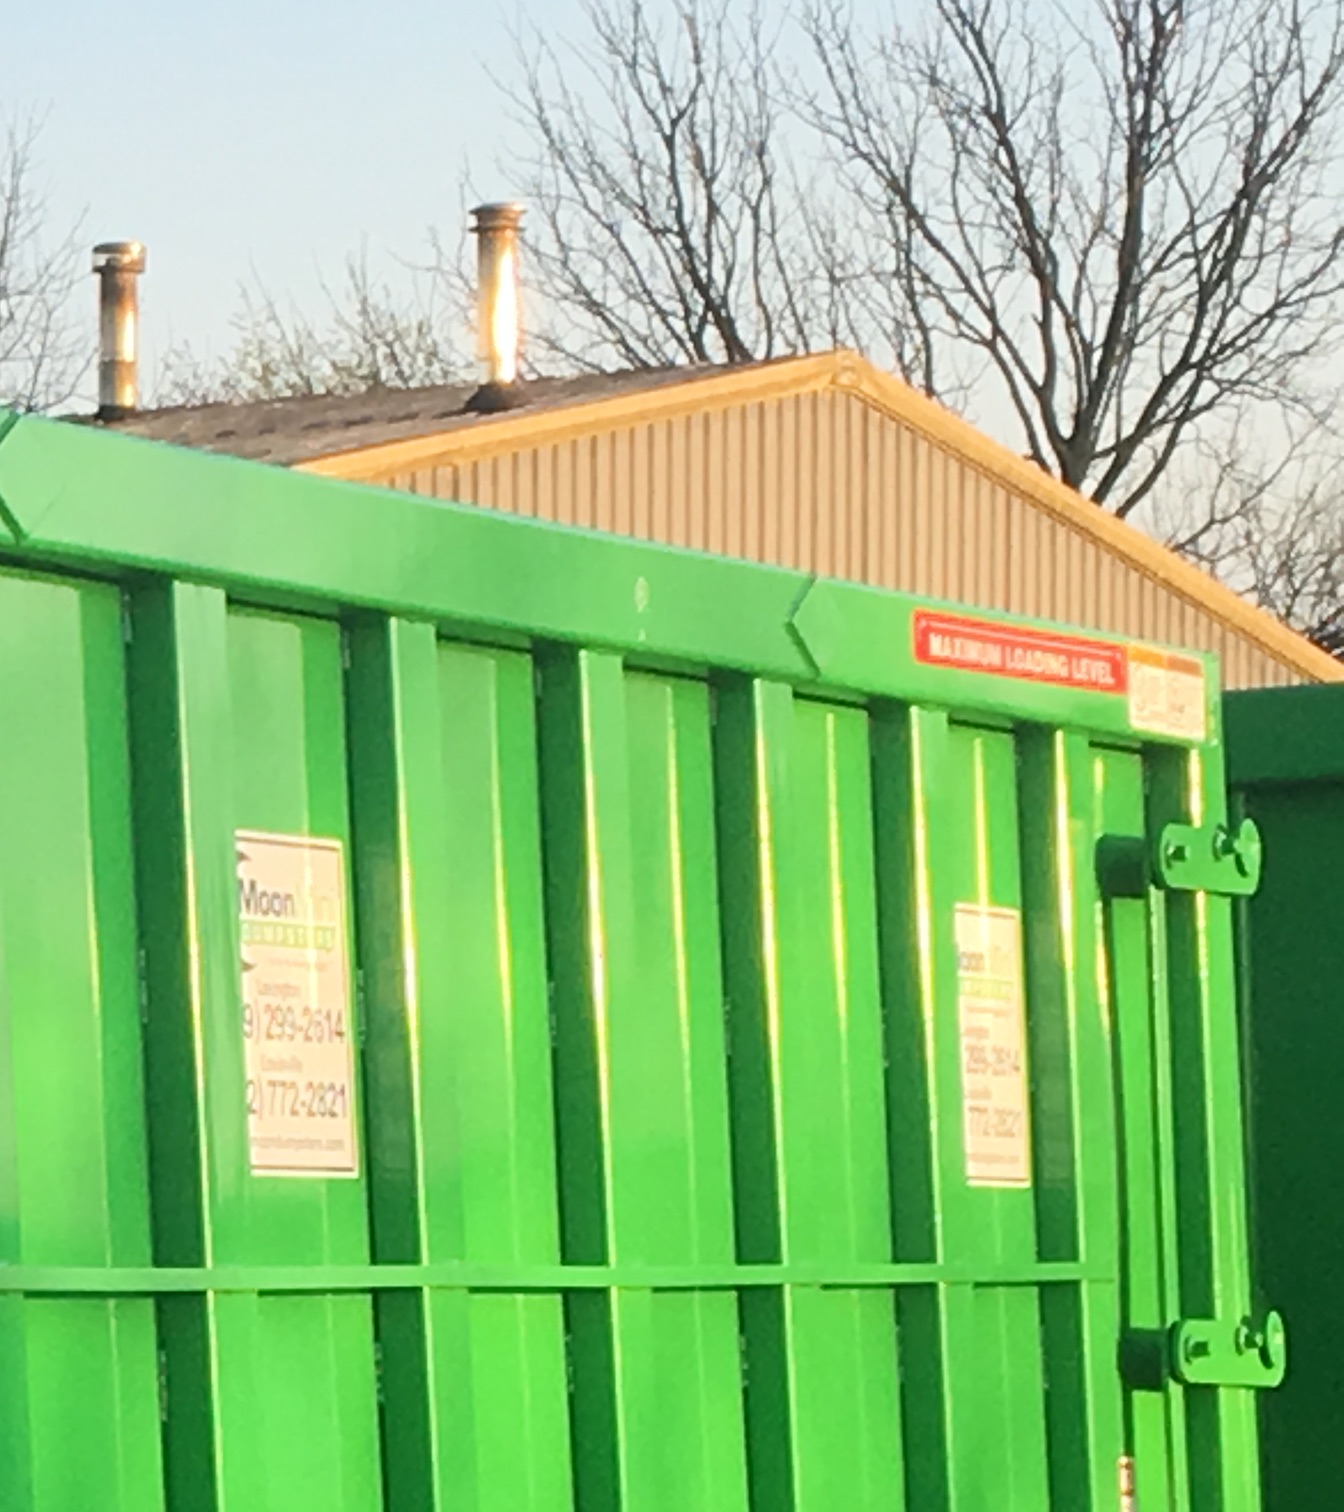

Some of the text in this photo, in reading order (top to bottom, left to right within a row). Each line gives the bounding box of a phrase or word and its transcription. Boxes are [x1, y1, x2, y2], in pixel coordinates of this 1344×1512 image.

[929, 633, 1115, 684] MAXIMUM LOADING LEVEL
